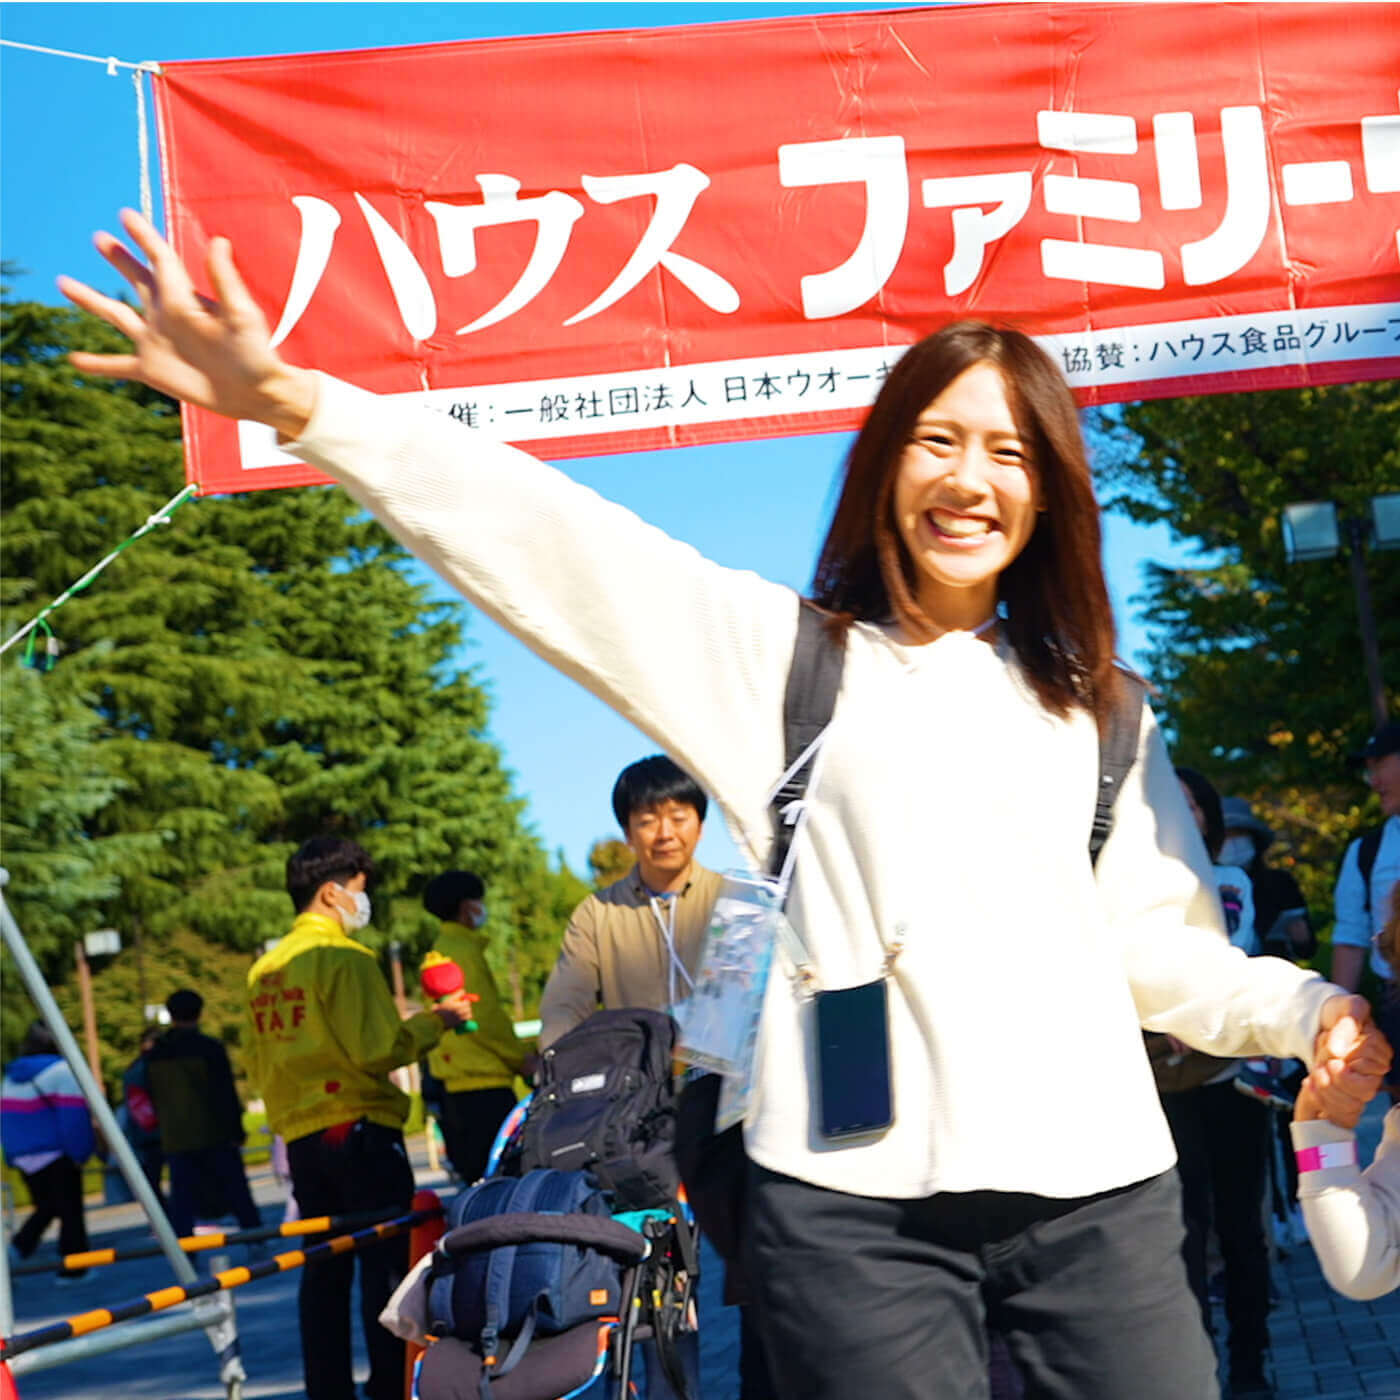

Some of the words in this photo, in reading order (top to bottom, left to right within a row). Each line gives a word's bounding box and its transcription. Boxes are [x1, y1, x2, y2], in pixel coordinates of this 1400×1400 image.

[268, 163, 740, 349] ハウス
[424, 379, 707, 429] 催：一般社団法人
